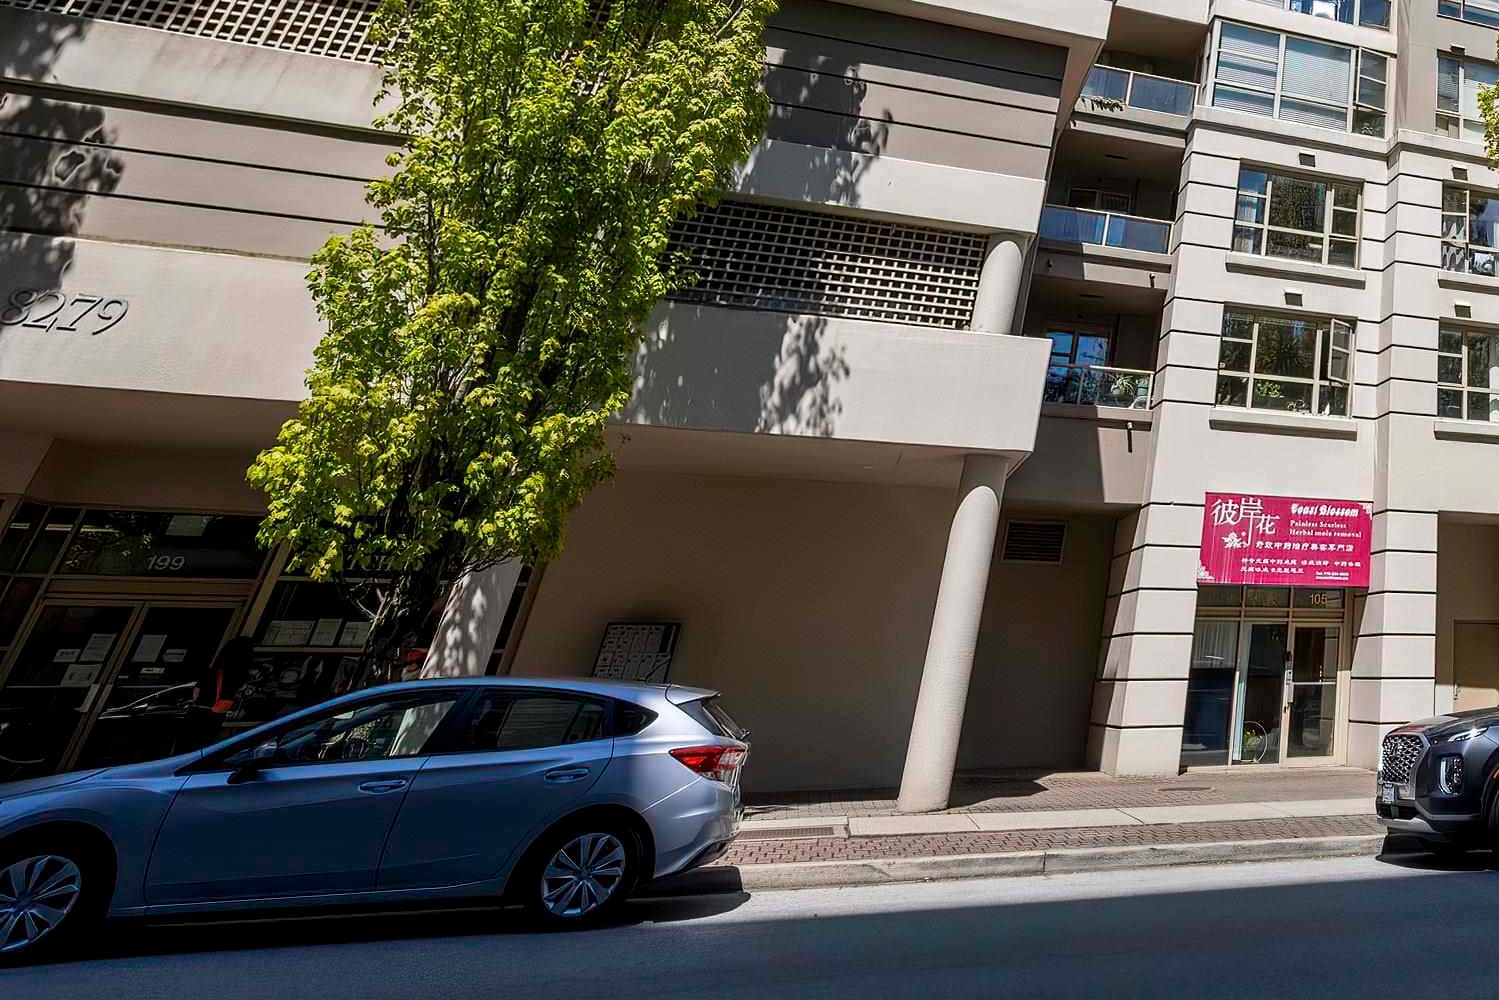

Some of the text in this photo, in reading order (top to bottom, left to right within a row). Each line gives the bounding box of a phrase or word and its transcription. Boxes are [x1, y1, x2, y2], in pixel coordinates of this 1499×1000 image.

[0, 290, 128, 336] 8279
[1319, 505, 1359, 518] Blossom
[1210, 497, 1281, 546] 彼岸花
[1290, 519, 1318, 528] Painless
[1289, 528, 1314, 536] Herbal
[1333, 531, 1362, 539] removal
[146, 555, 185, 570] 199
[1310, 593, 1328, 606] 105
